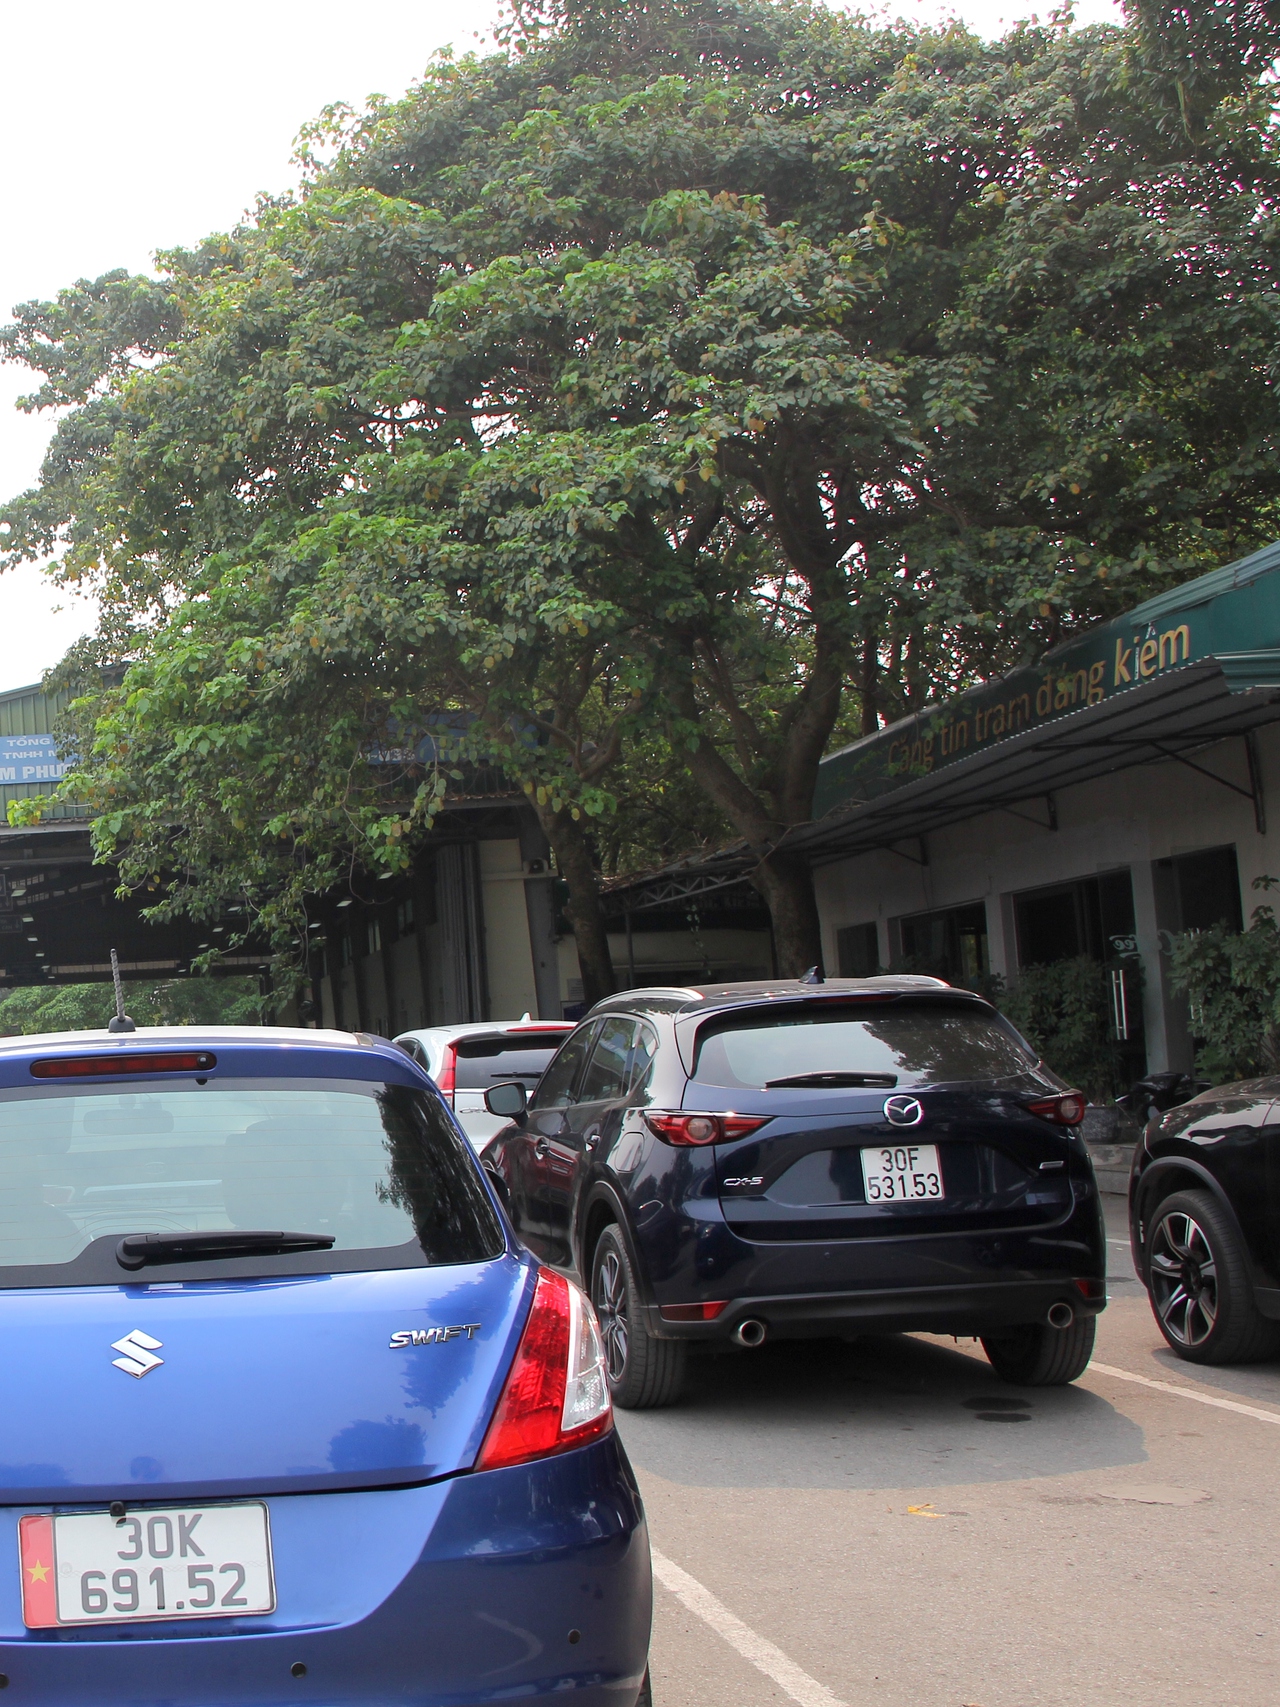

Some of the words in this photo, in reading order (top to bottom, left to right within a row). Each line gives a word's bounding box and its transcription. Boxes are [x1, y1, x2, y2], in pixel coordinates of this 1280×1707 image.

[7, 735, 50, 747] TỔNG
[941, 717, 968, 755] tin
[3, 750, 43, 759] TNHH
[881, 1147, 919, 1173] 30F
[723, 1176, 764, 1187] CX-5
[868, 1173, 940, 1200] 531.53
[389, 1323, 482, 1349] SWIFT
[115, 1513, 206, 1560] 30K
[80, 1562, 248, 1614] 691.52
